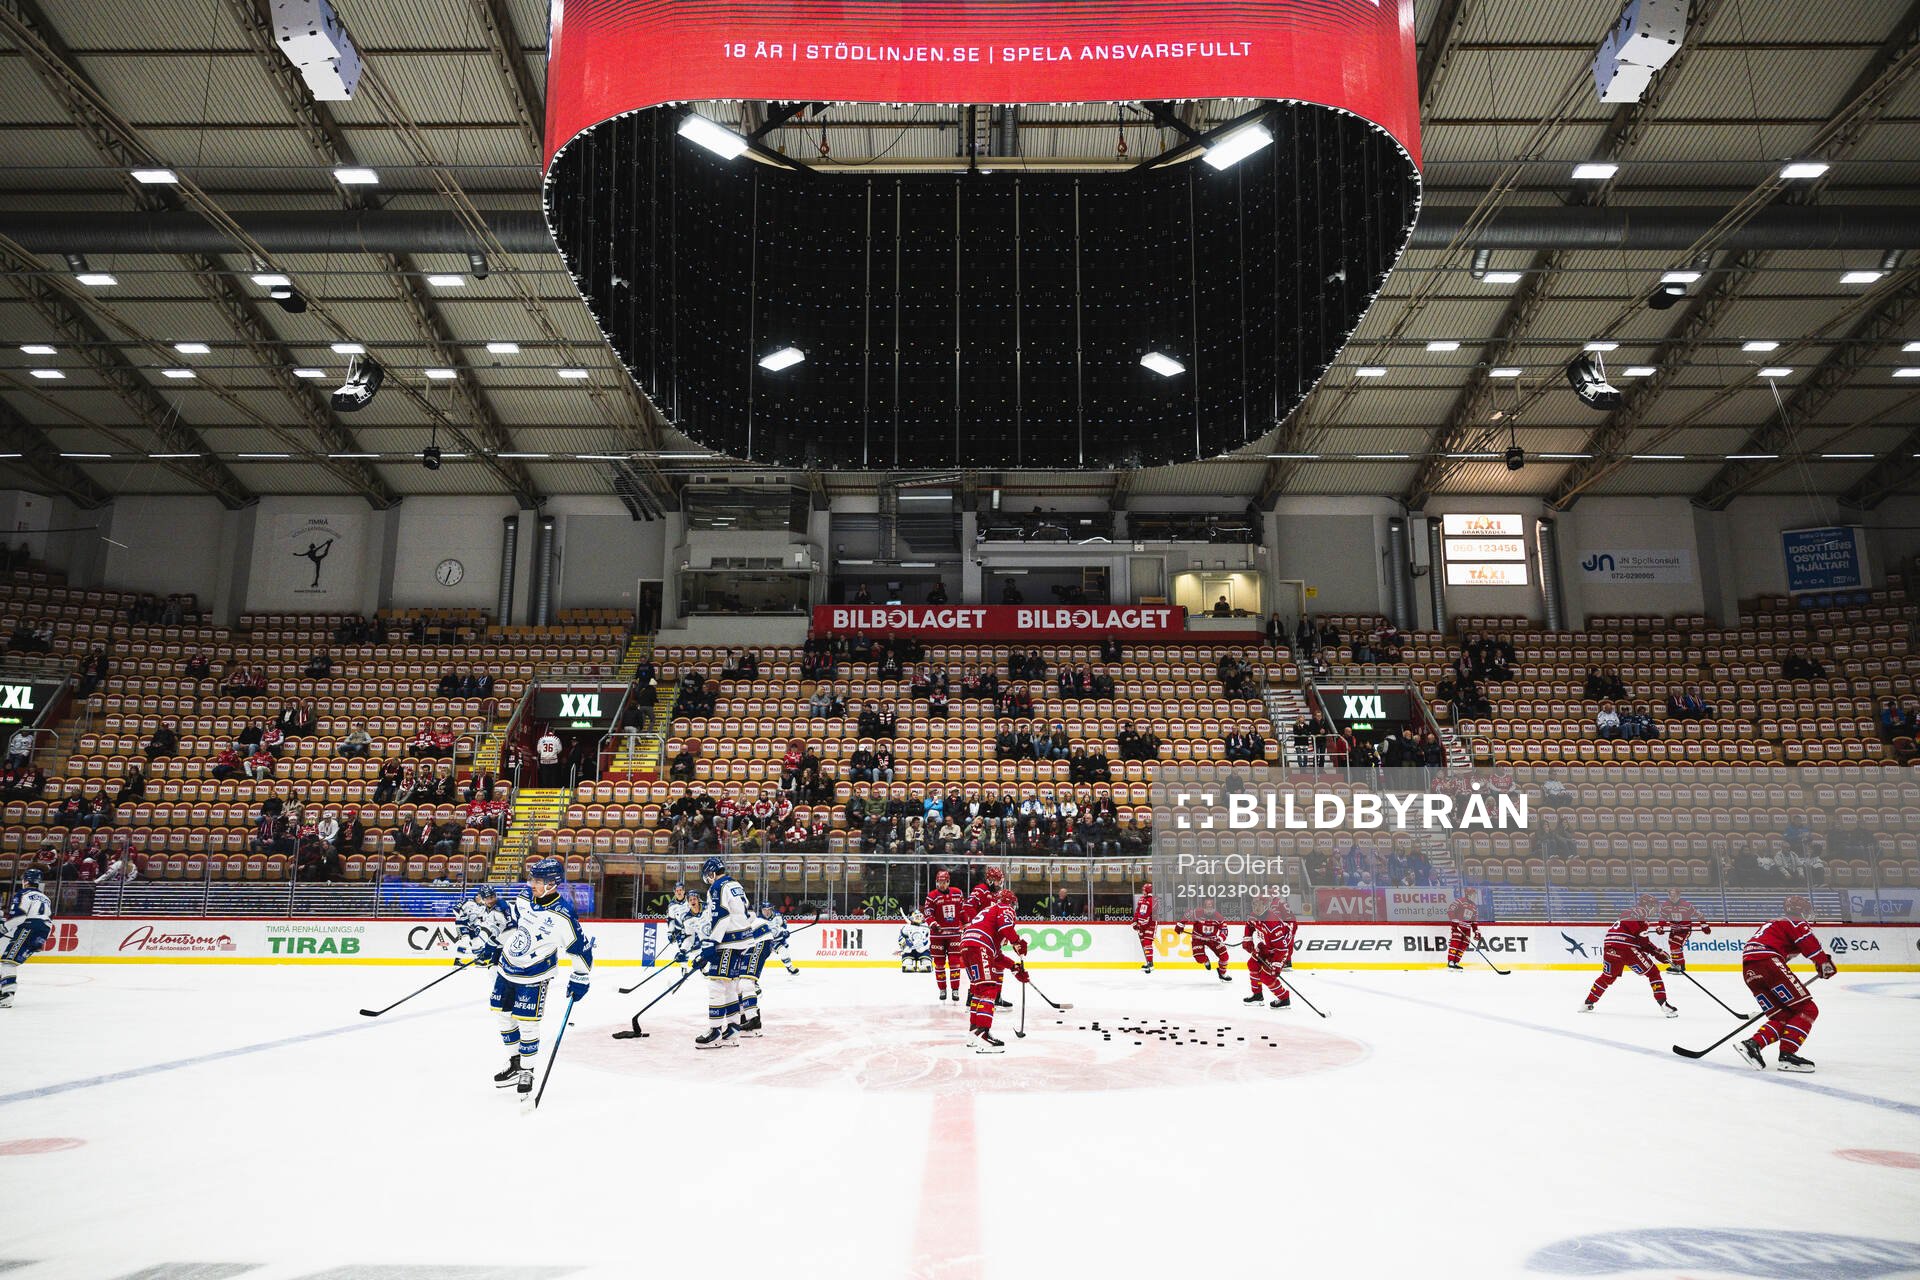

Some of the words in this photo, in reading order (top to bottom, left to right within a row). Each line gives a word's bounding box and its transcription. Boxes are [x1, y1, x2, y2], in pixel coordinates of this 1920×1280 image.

[724, 43, 745, 58] 18
[755, 41, 783, 59] ÅR
[806, 42, 980, 62] STÖDLINJEN.SE
[1003, 46, 1073, 62] SPELA
[1080, 42, 1252, 60] ANSVARSFULLT
[1465, 519, 1502, 530] TAXI
[1789, 541, 1852, 553] IDROTTENS
[1793, 551, 1850, 563] OSYNLIGA
[1469, 569, 1505, 579] TAXI
[833, 609, 987, 629] BILBOLAGET
[1017, 609, 1171, 629] BILBOLAGET
[0, 685, 34, 709] XL
[559, 693, 602, 717] XXL
[1343, 695, 1386, 719] XXL
[543, 743, 553, 753] 36
[1393, 893, 1447, 903] BUCHER
[1327, 897, 1377, 914] AVIS
[1427, 907, 1447, 916] glass
[266, 924, 289, 933] TIMRÅ
[291, 924, 352, 933] RENHÅLLNINGS
[354, 925, 365, 933] AB
[268, 937, 361, 954] TIRAB
[643, 927, 656, 957] NRS
[1851, 940, 1880, 951] SCA
